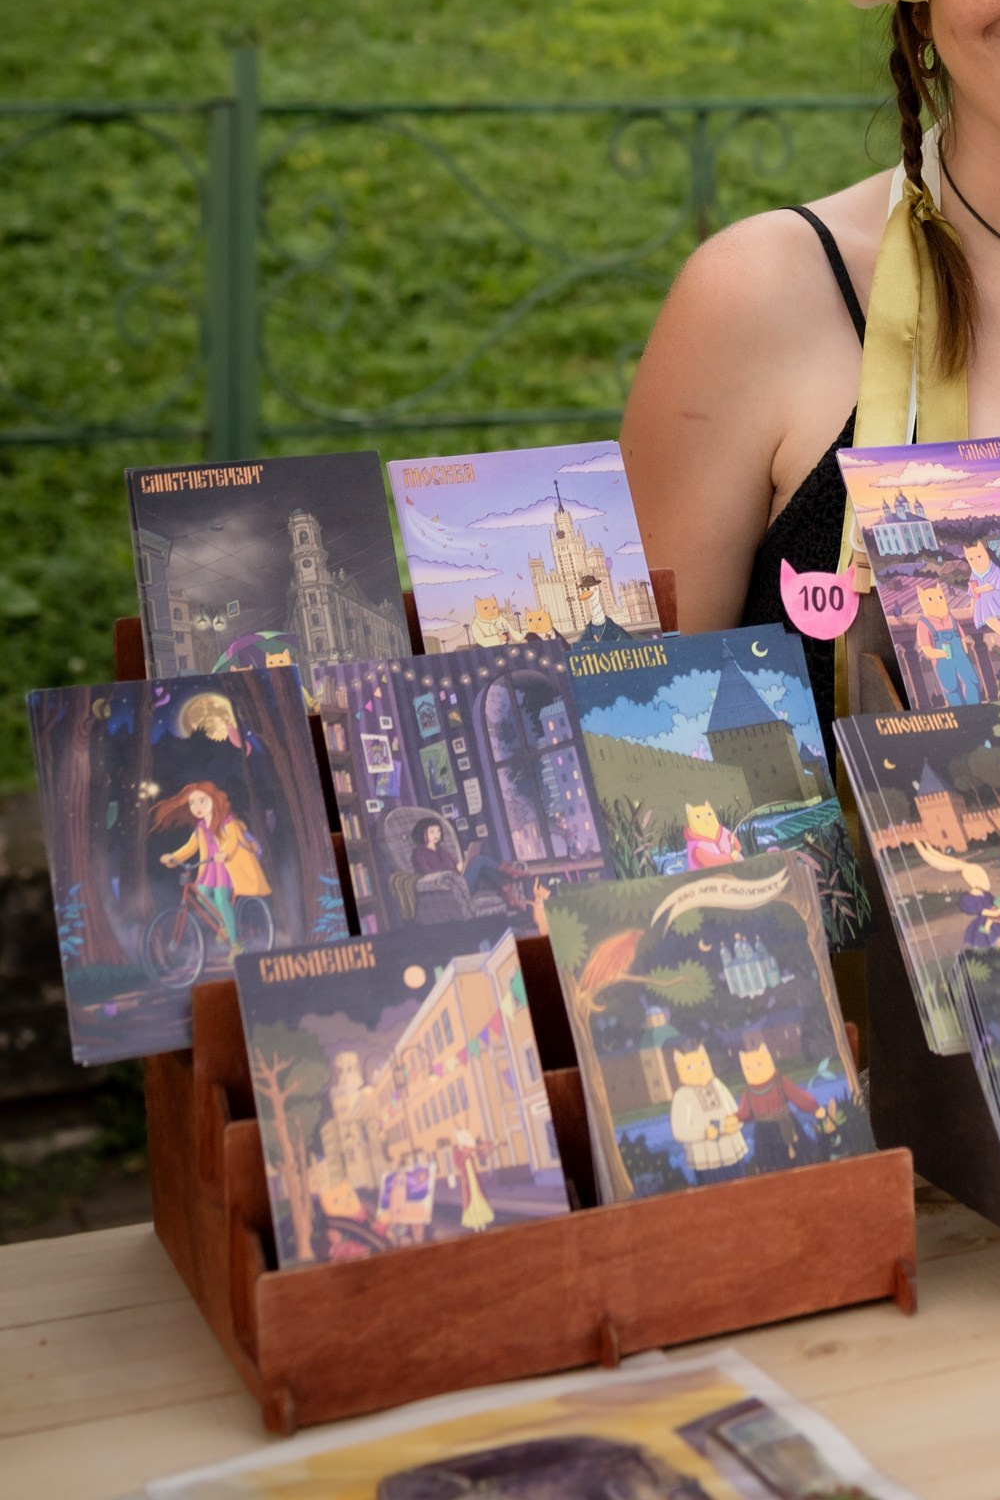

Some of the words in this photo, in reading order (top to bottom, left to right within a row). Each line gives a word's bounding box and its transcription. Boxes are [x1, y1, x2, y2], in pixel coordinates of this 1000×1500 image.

[141, 465, 264, 494] САНКТ-ПЕТЕРБУРГ
[402, 463, 475, 489] МОСКВА
[799, 585, 844, 612] 100
[569, 644, 668, 677] СМОЛЕНСК
[875, 712, 959, 735] СМОЛЕНСК
[259, 941, 376, 984] СМОЛЕНСК
